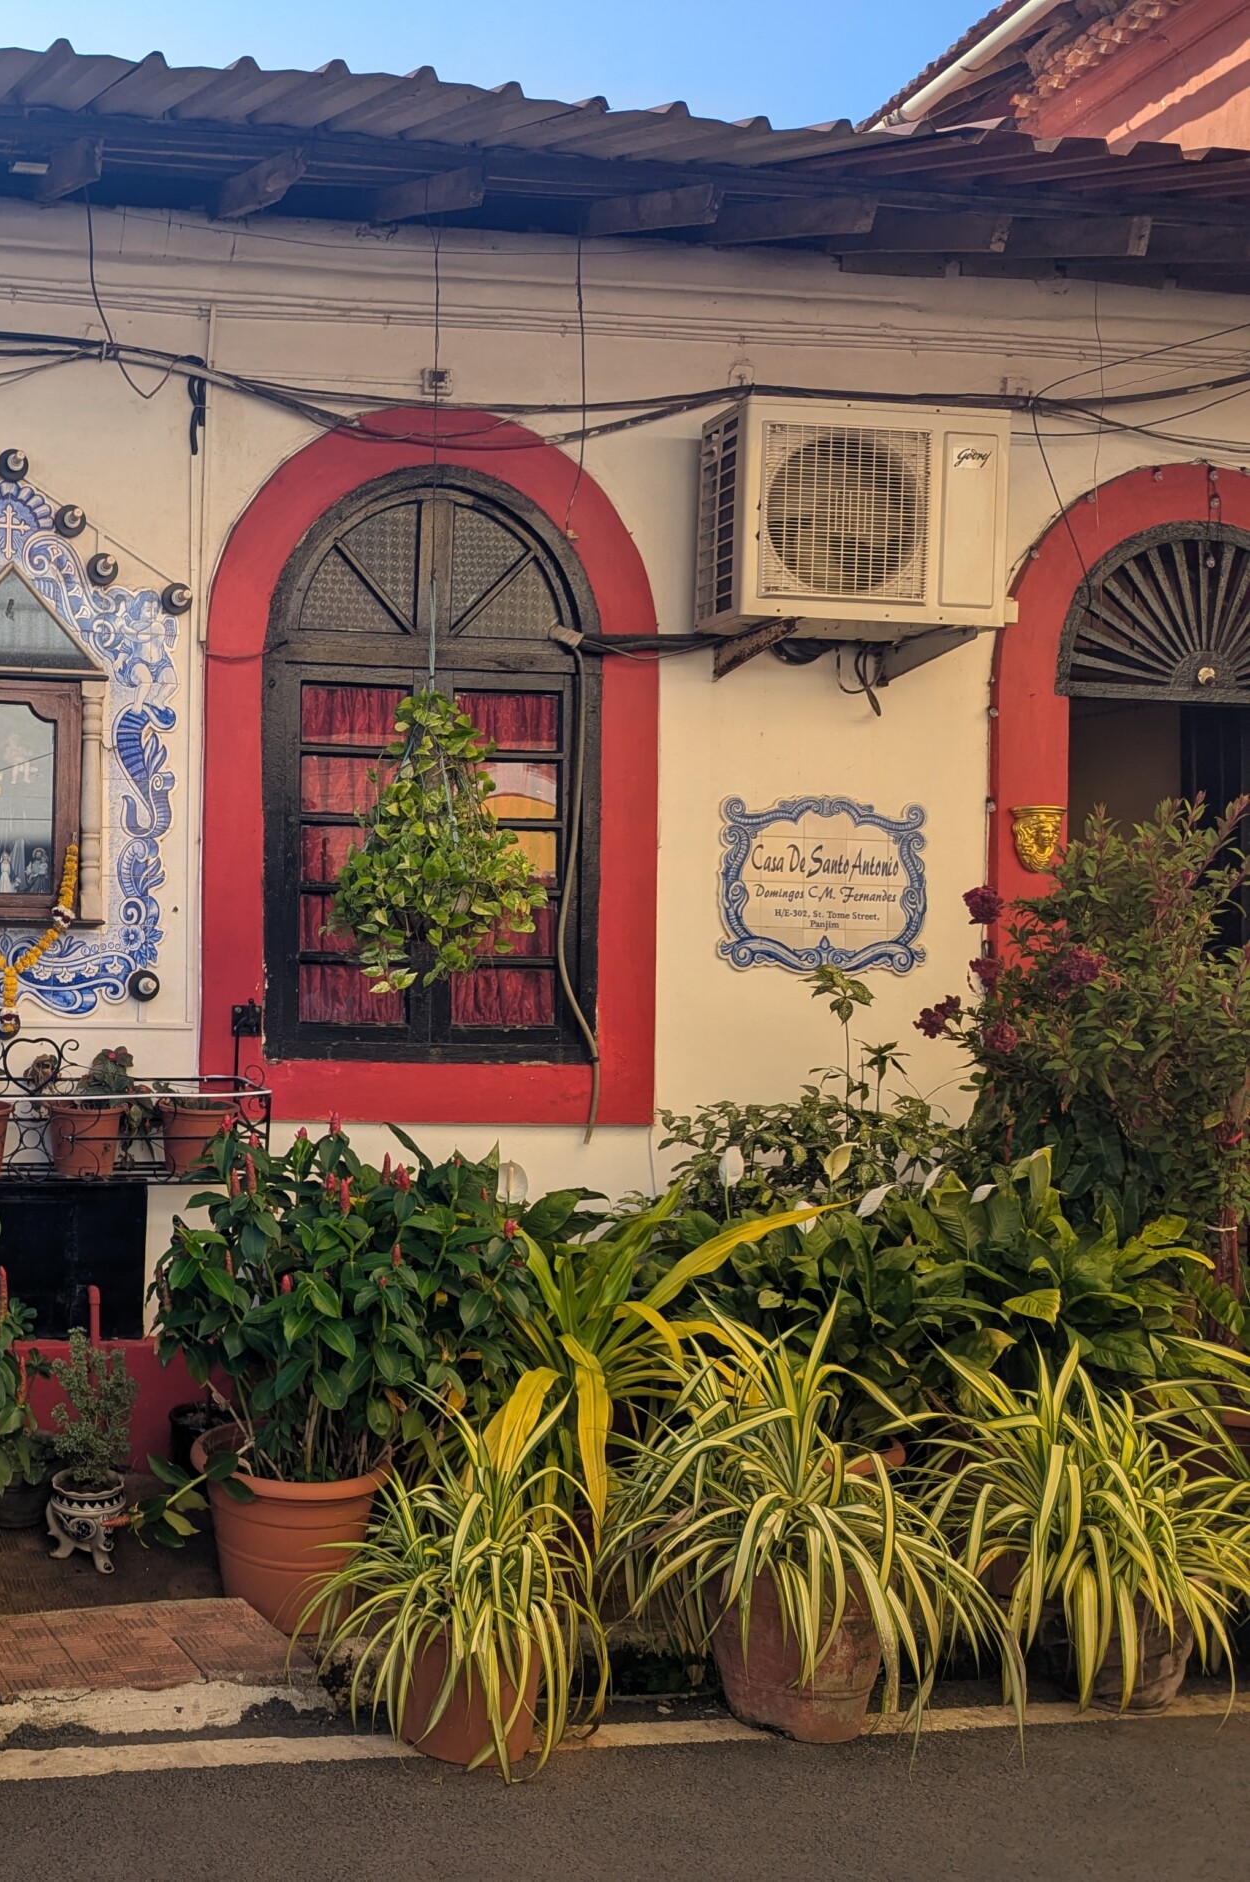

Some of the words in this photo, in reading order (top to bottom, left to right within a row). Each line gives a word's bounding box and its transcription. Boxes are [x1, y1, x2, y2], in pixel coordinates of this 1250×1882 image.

[954, 448, 992, 468] Godrej
[751, 843, 785, 873] Casa
[786, 843, 806, 873] De
[806, 844, 849, 879] Santo
[848, 847, 899, 882] Antonio
[752, 883, 805, 903] Domingos
[839, 886, 897, 904] Fernandes
[810, 920, 839, 931] Panjim
[812, 910, 825, 919] St.
[826, 910, 851, 920] Tome
[852, 911, 880, 921] Street,
